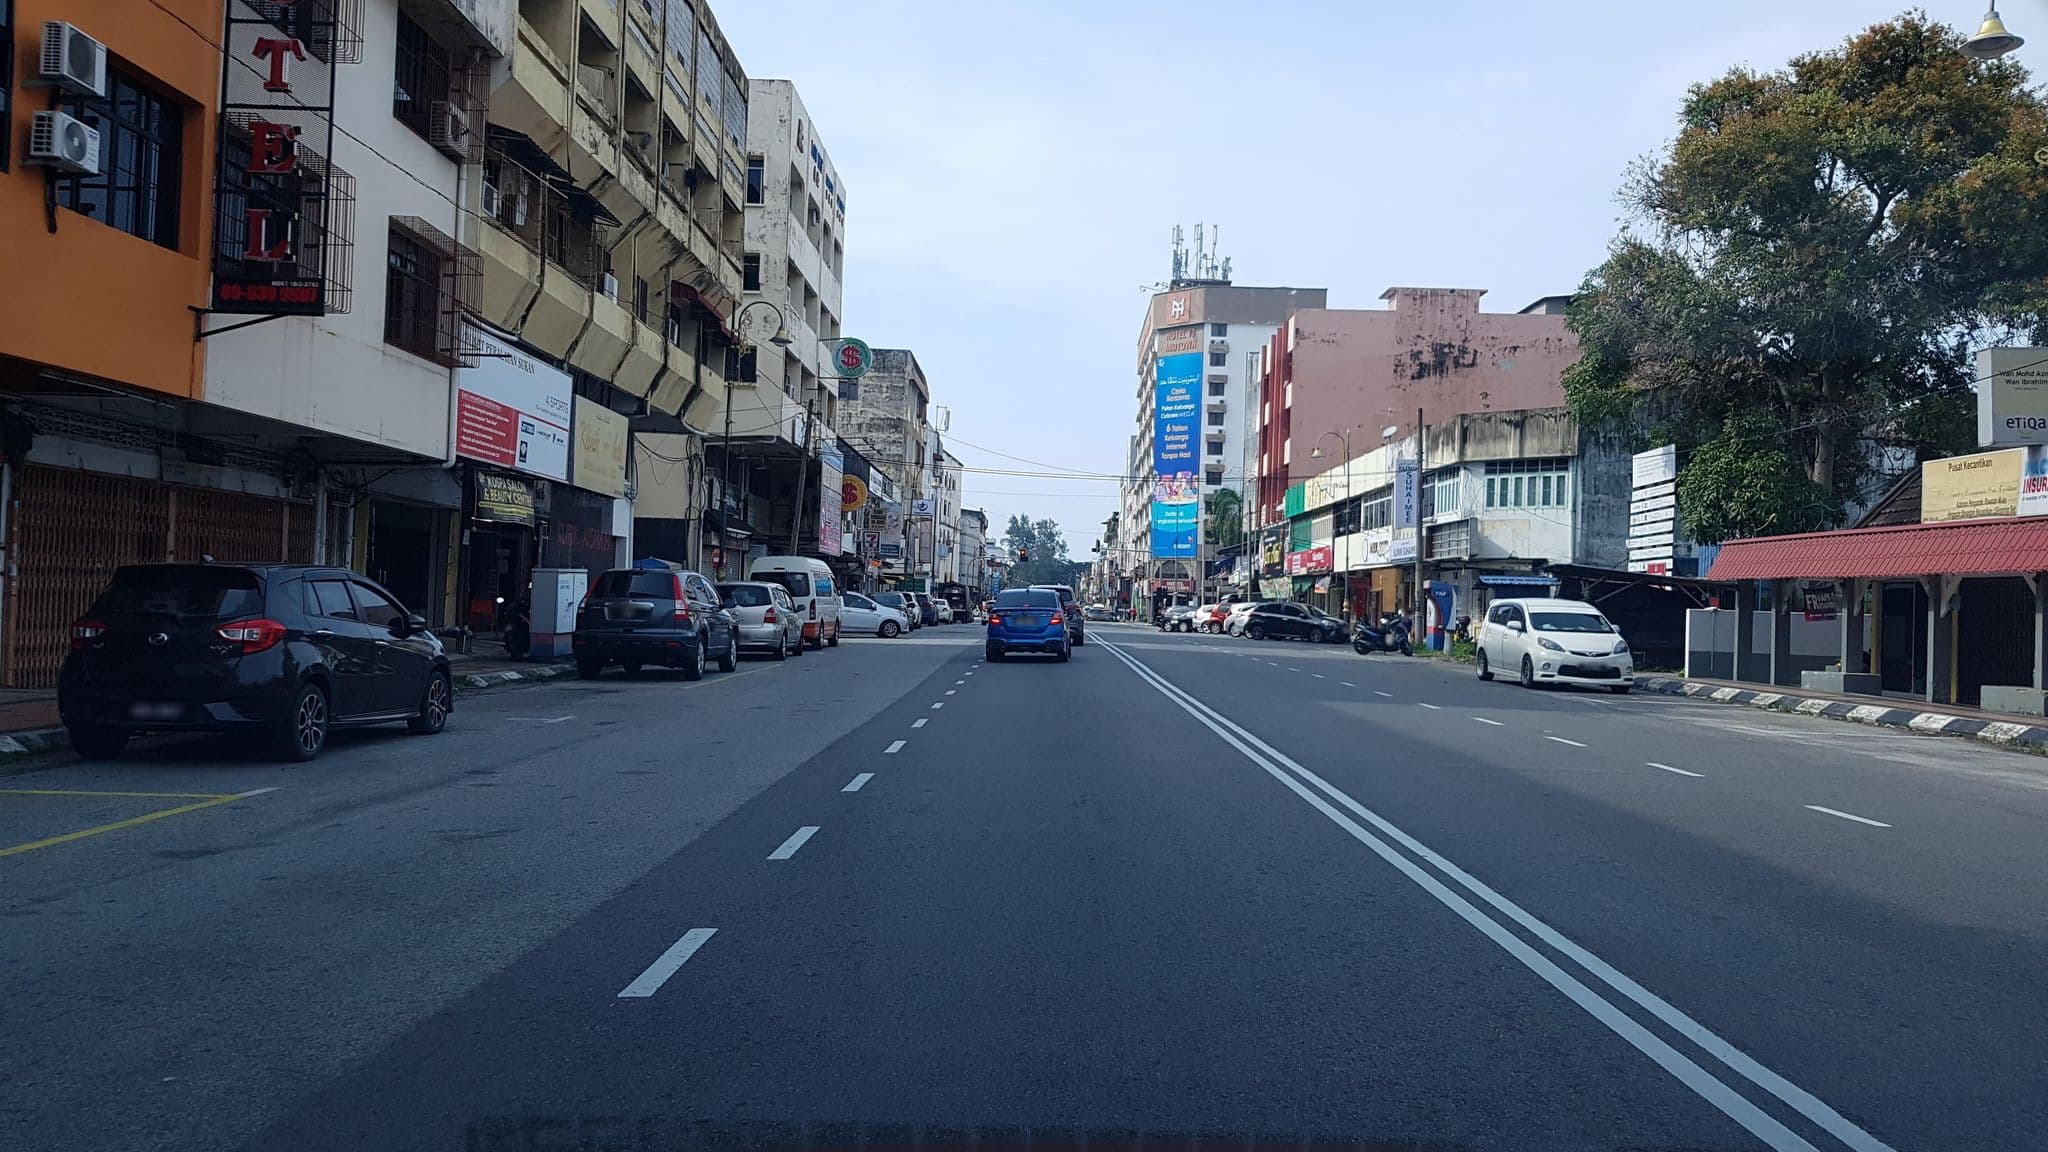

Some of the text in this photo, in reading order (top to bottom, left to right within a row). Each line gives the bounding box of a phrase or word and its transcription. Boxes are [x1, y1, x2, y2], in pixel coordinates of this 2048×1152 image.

[244, 0, 306, 263] TEL
[1948, 458, 1993, 472] Pusat Kecantikan
